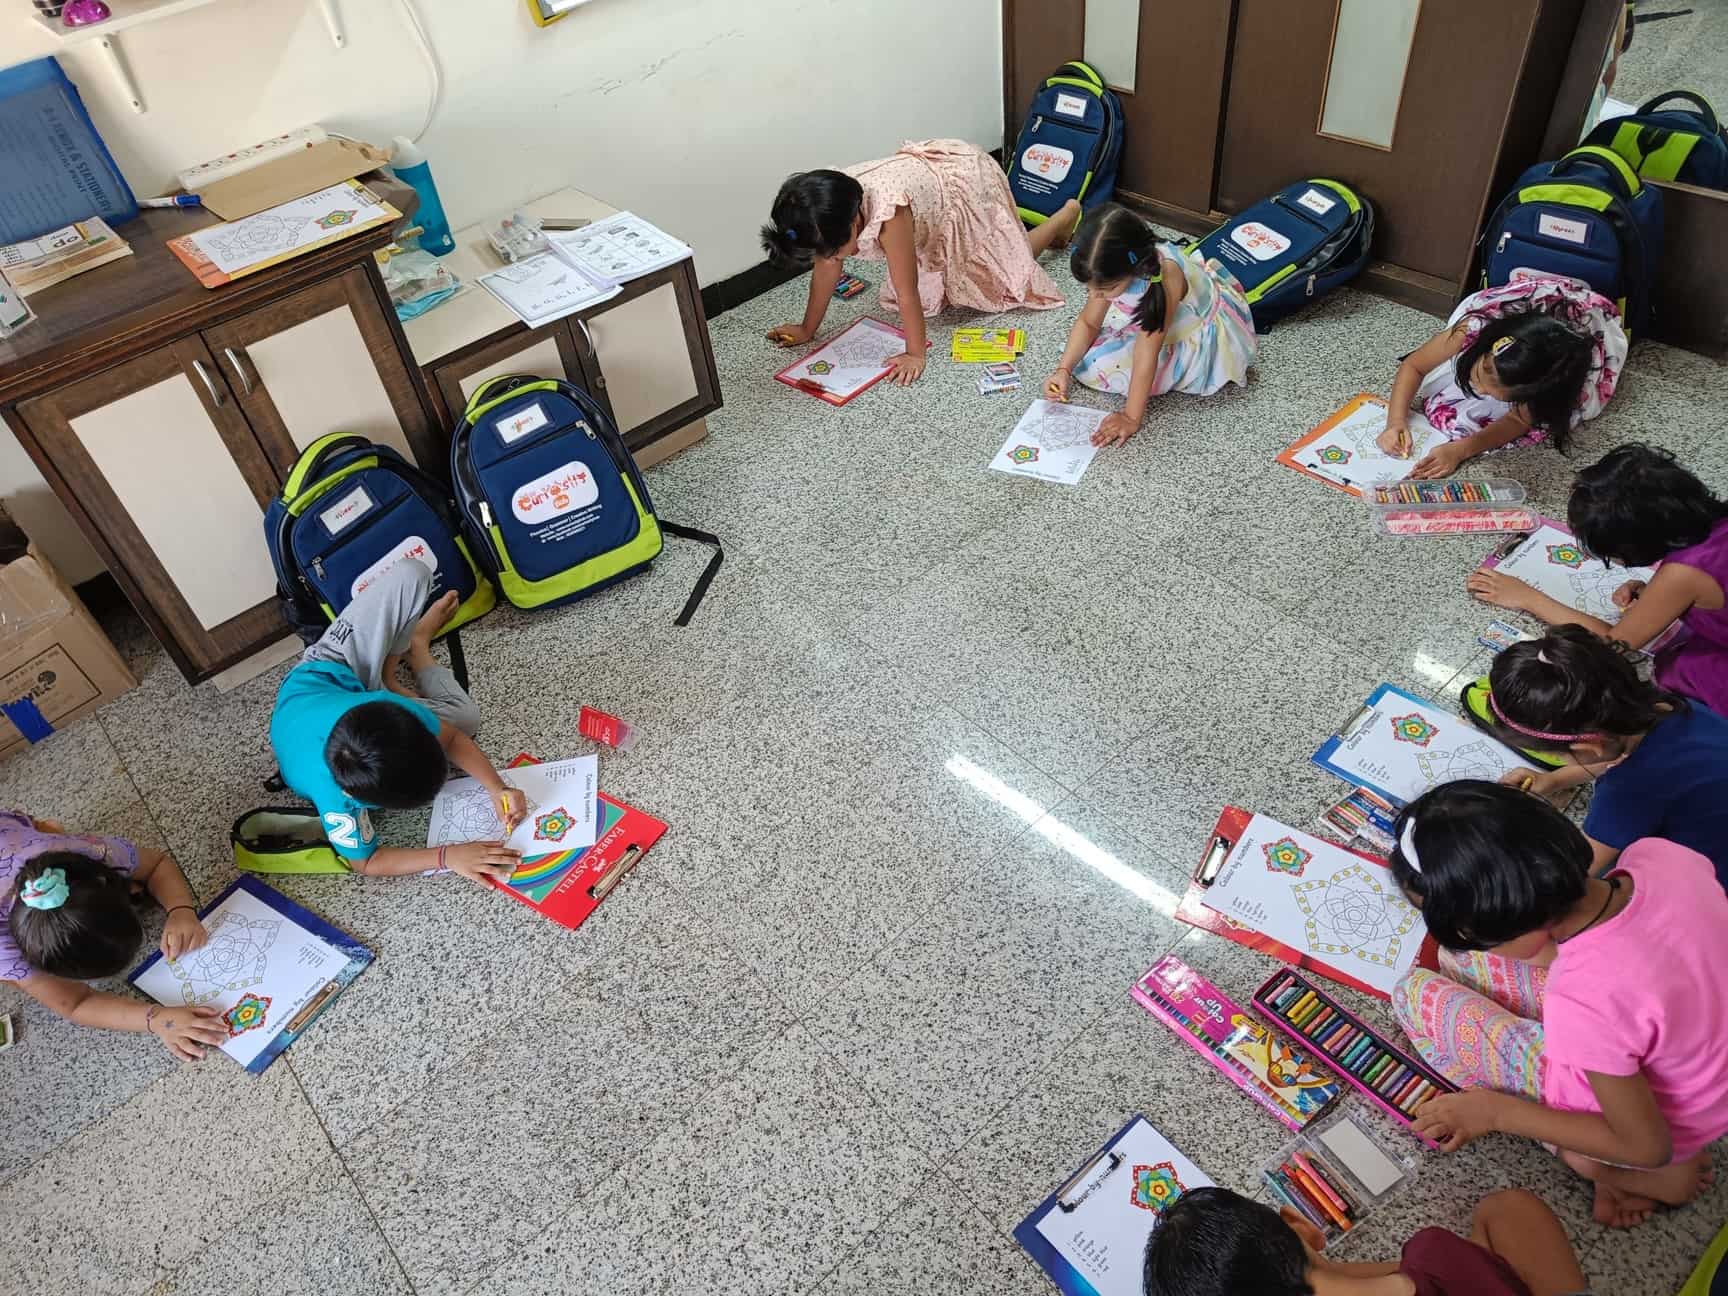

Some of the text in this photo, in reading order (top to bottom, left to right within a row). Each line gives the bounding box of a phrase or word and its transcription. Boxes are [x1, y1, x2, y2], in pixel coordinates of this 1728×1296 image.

[518, 472, 587, 511] Curiosity
[582, 799, 593, 823] numbers
[555, 826, 625, 895] FABER-CASTELL
[305, 977, 326, 996] Colour
[267, 1008, 294, 1034] numbers
